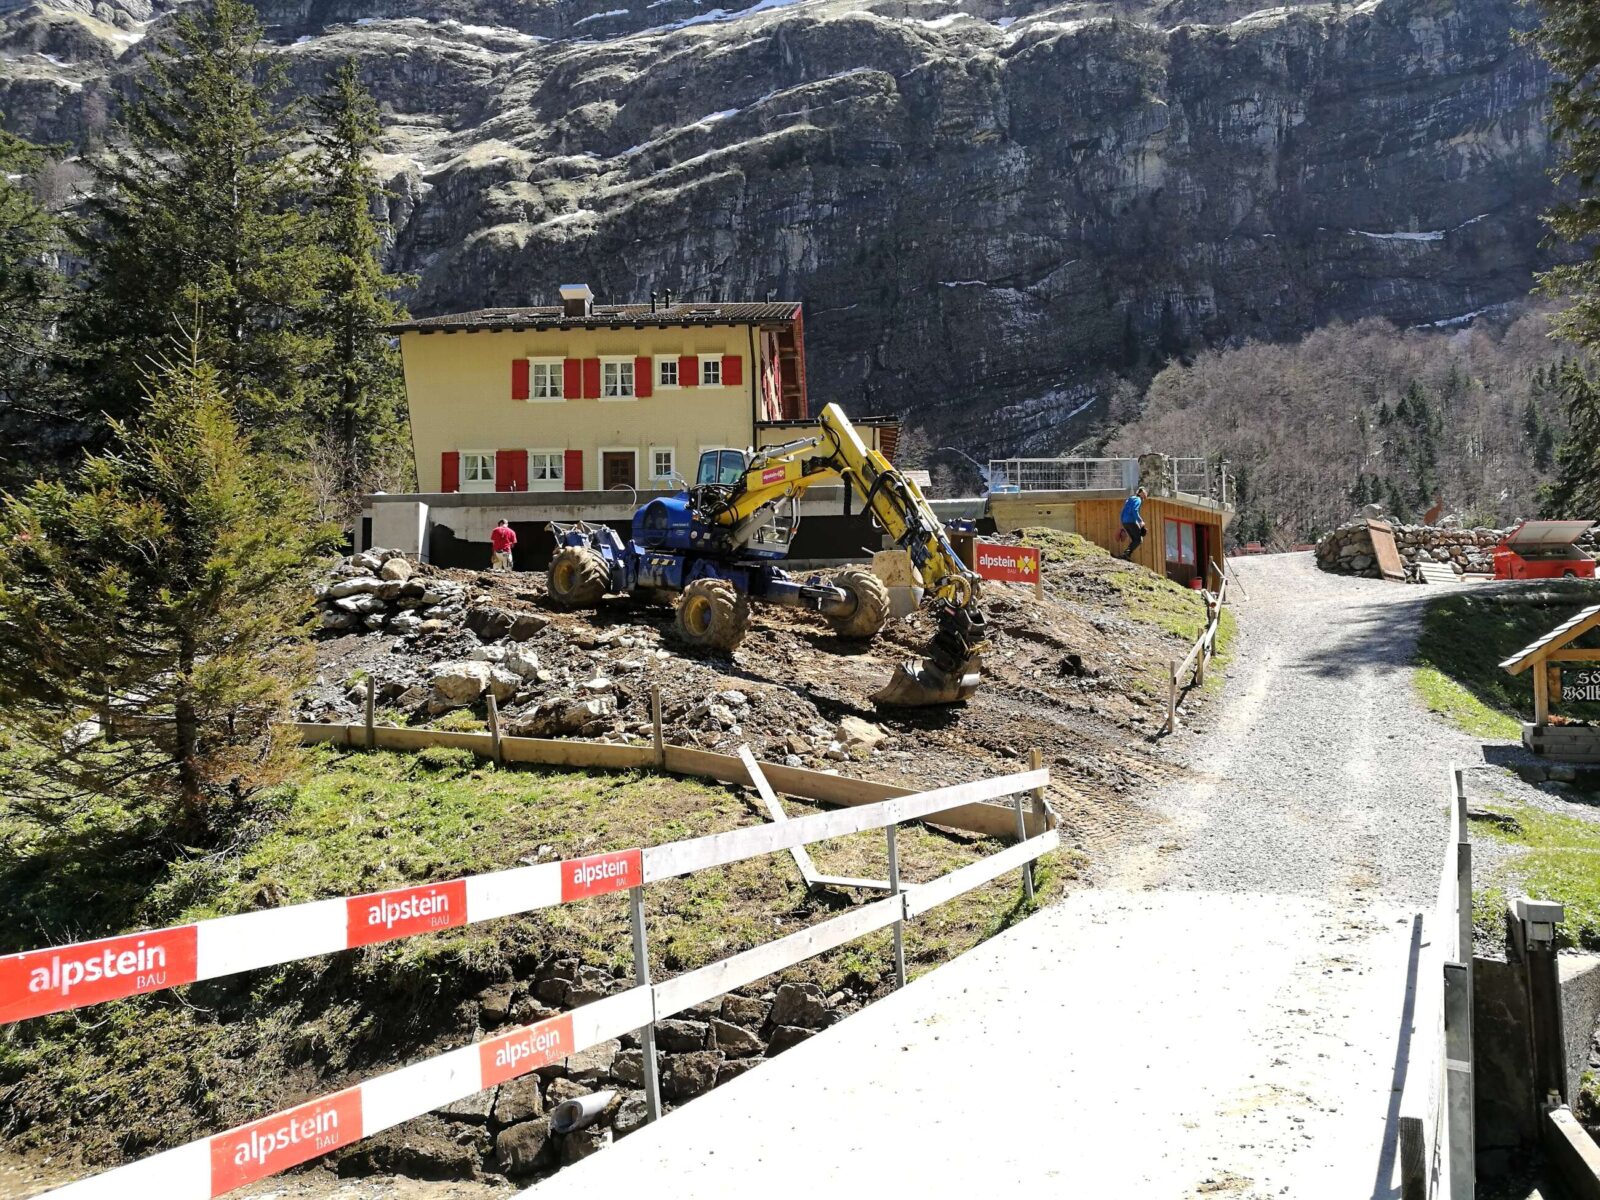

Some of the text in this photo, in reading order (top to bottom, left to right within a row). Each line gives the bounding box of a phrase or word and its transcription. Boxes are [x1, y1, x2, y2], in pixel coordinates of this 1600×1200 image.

[980, 553, 1016, 569] alpstein
[573, 856, 628, 887] alpstein
[368, 890, 449, 929] alpstein
[431, 914, 450, 927] BAU
[28, 940, 166, 996] alpstein
[136, 971, 167, 989] BAU
[496, 1027, 560, 1068] alpstein
[234, 1107, 338, 1165] alpstein
[315, 1131, 340, 1151] BAU
